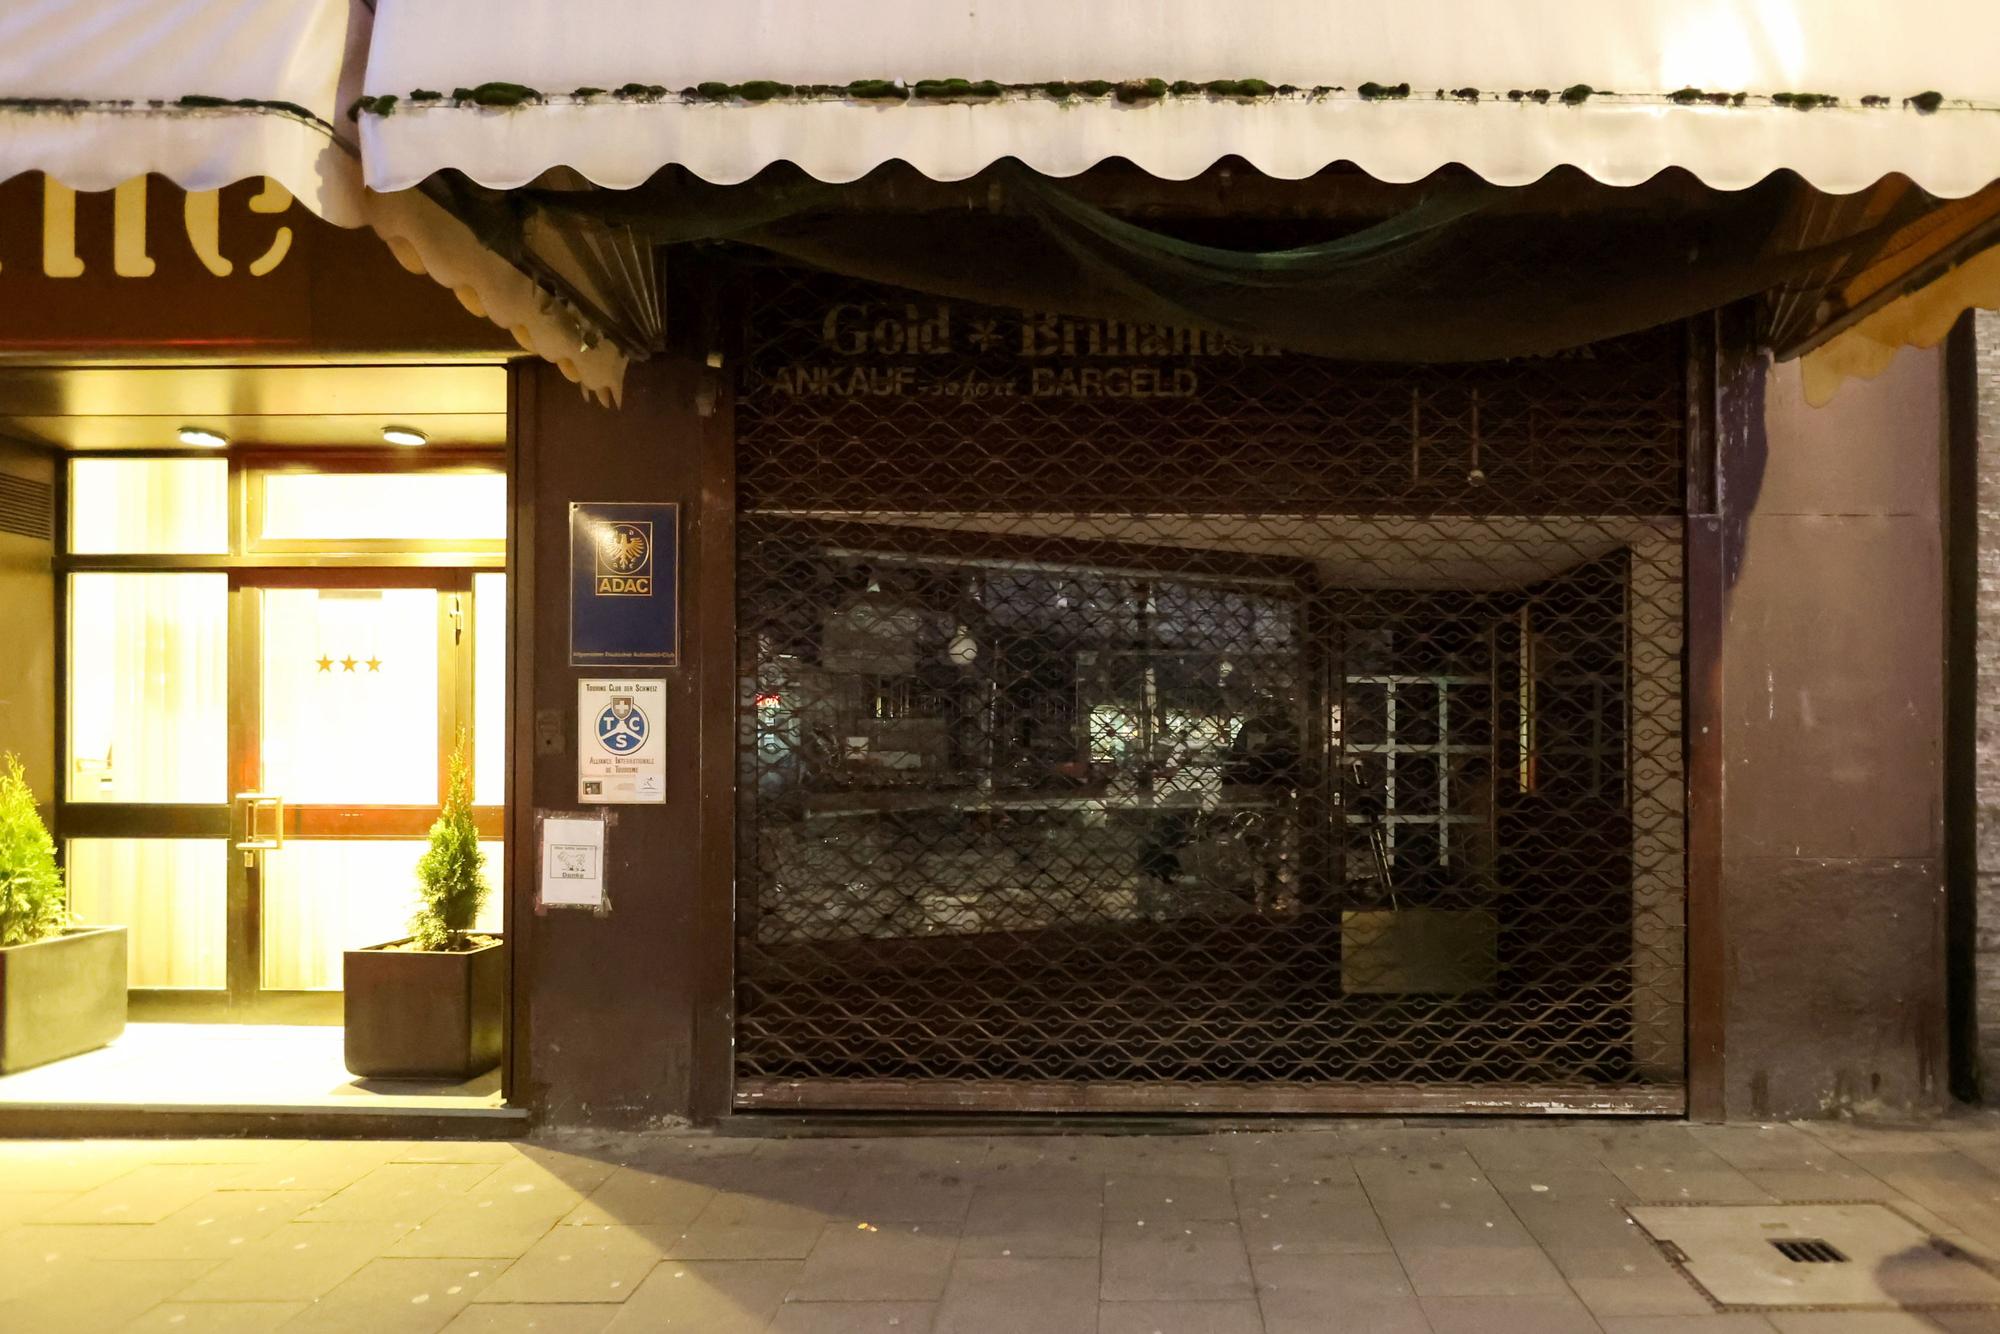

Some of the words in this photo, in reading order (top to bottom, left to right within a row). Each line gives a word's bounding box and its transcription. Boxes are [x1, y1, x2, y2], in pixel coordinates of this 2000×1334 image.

[823, 303, 953, 356] Gold
[771, 366, 917, 397] ANKAUF
[600, 578, 649, 593] ADAC
